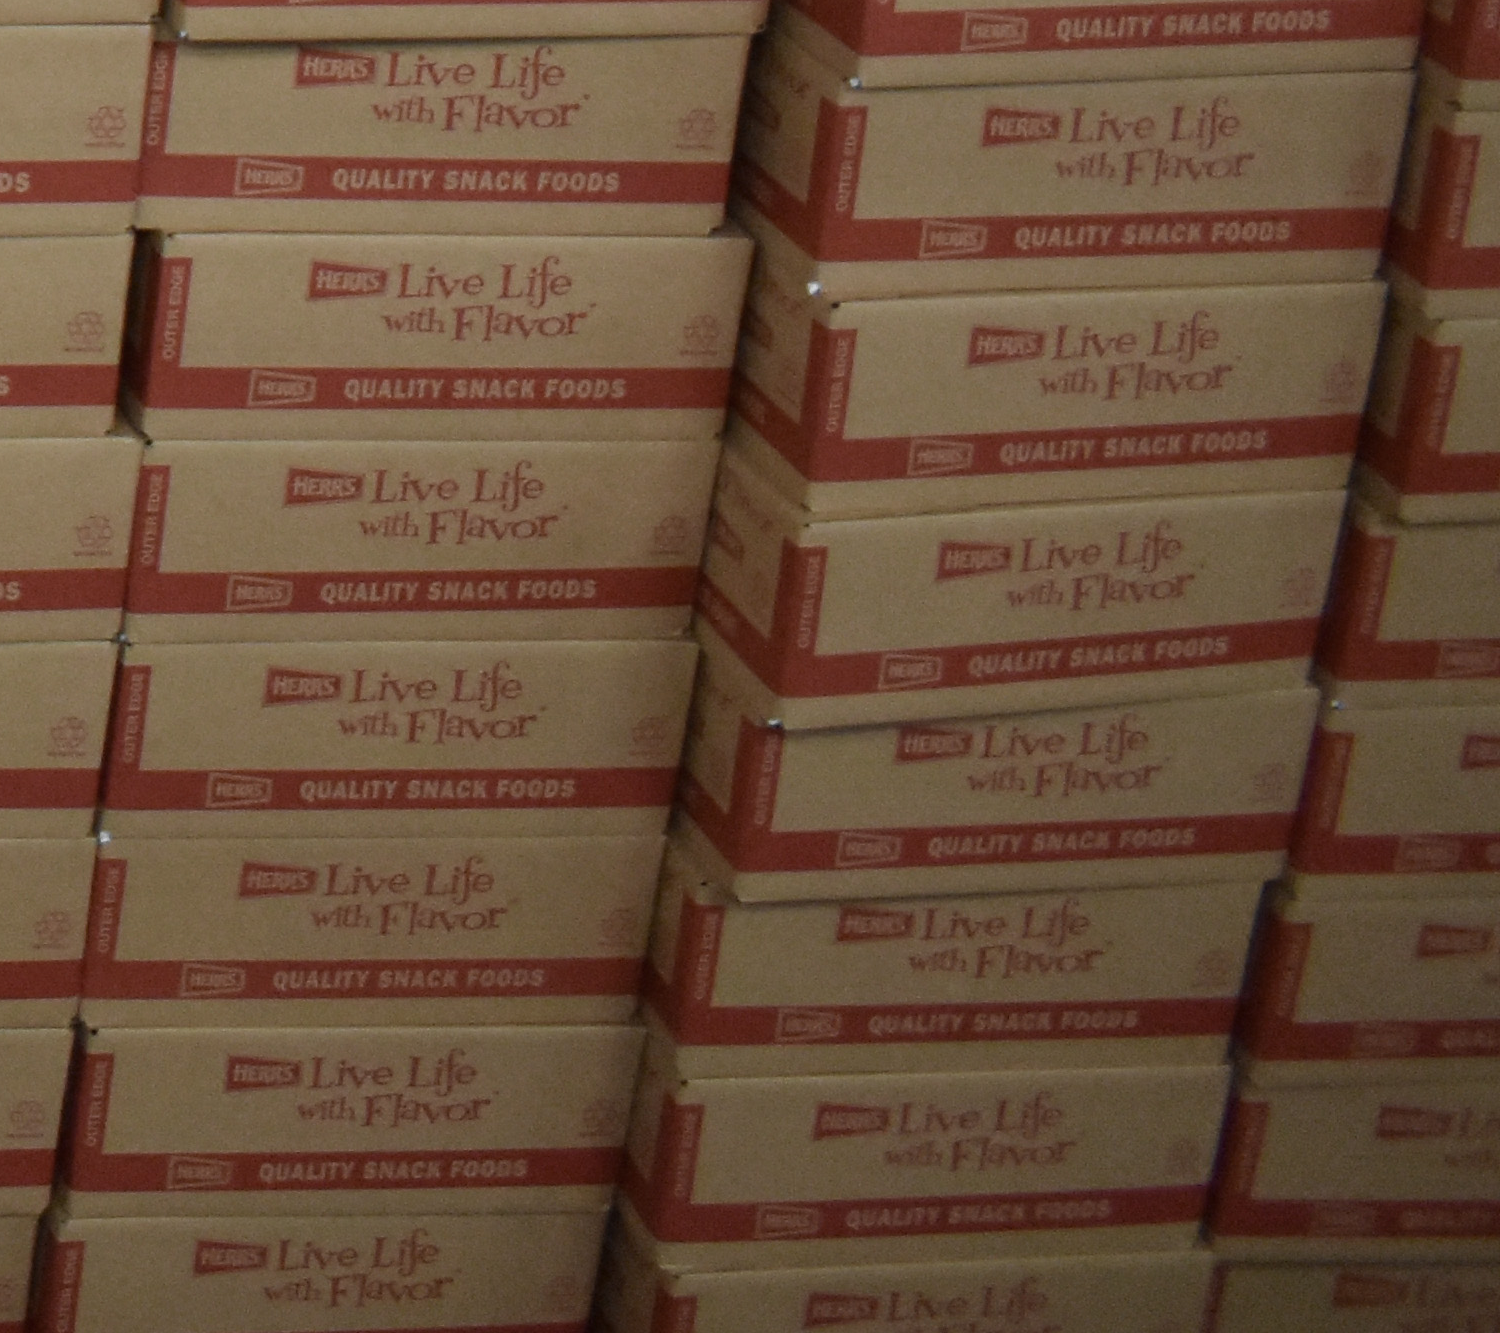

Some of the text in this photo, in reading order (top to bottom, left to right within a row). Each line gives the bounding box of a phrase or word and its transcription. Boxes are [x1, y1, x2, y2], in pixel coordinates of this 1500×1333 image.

[1056, 16, 1155, 41] QUALITY
[1163, 13, 1243, 35] SNACK
[1253, 9, 1330, 33] FOODS
